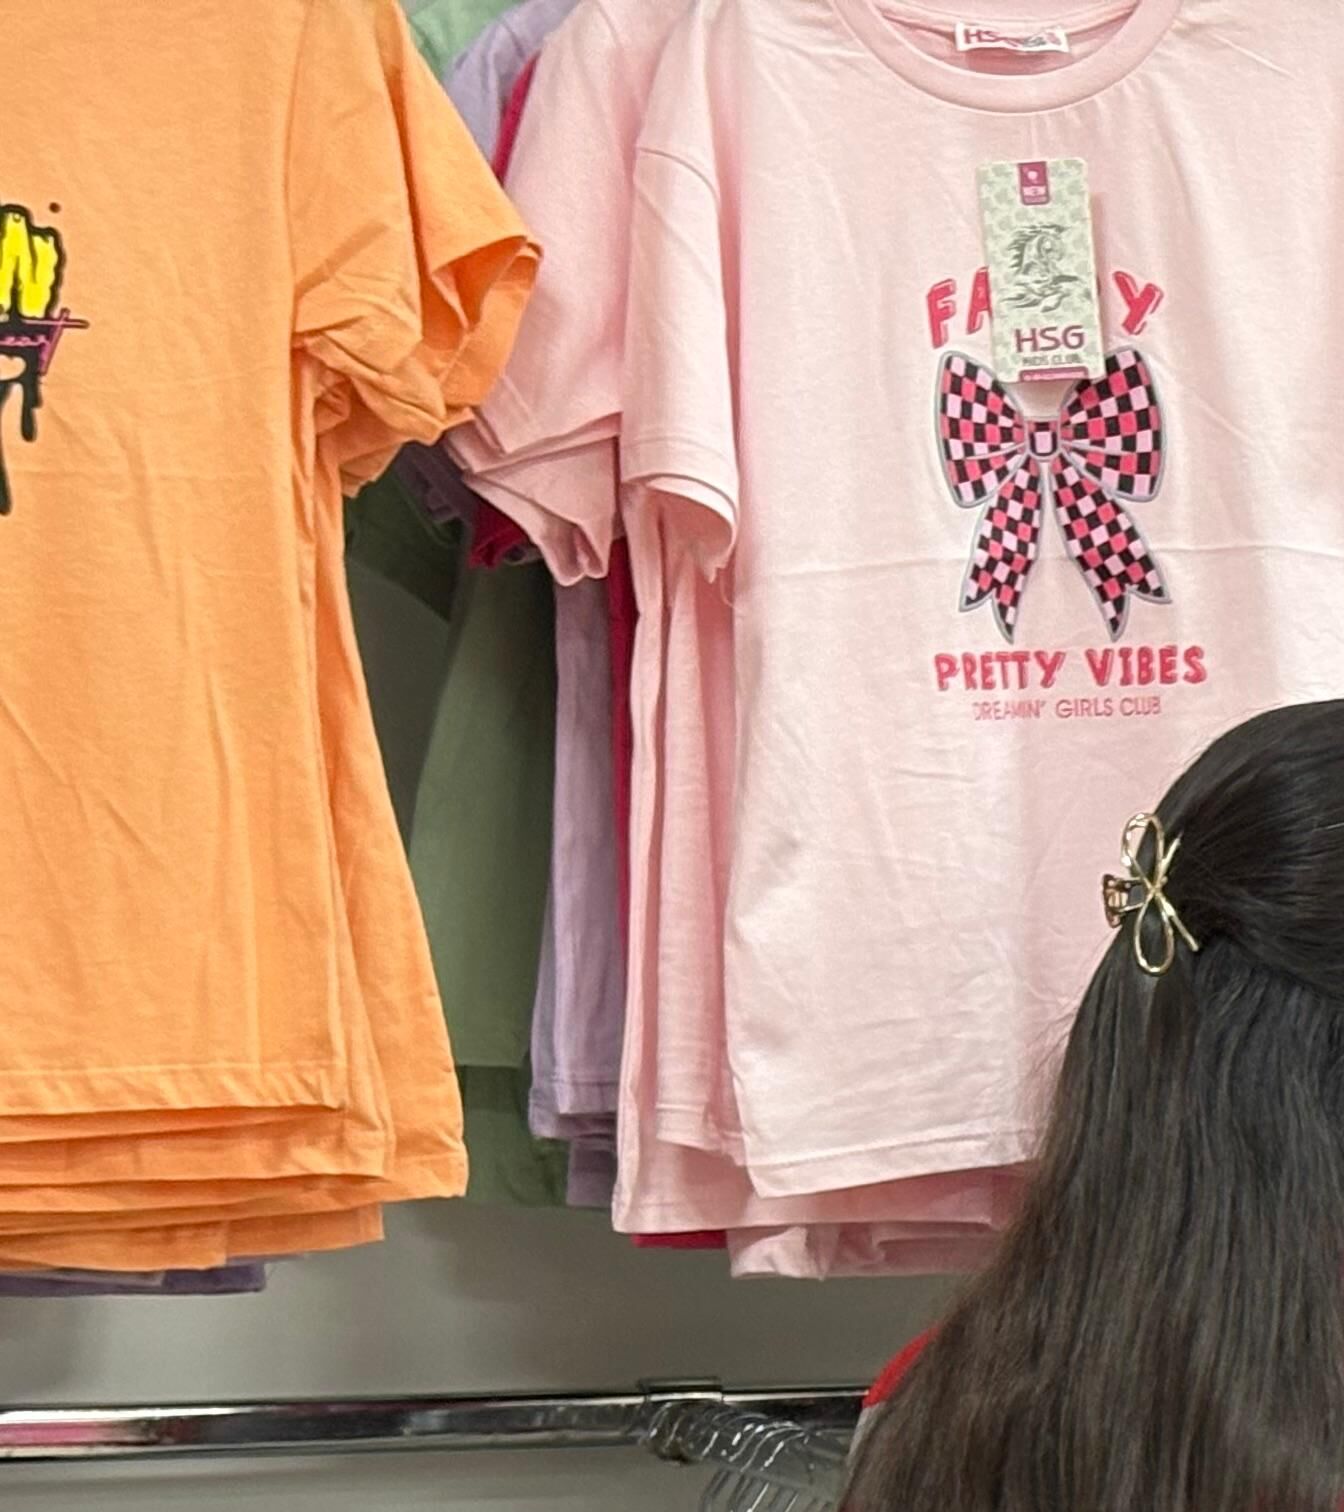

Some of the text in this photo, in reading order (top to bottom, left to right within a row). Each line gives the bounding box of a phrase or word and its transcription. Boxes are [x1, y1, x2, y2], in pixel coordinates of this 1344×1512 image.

[926, 266, 1163, 349] FAY
[1014, 325, 1084, 353] HSG
[934, 645, 1208, 691] PRETTY VIBES
[1055, 697, 1113, 719] GIRLS
[1119, 696, 1161, 716] CLUB
